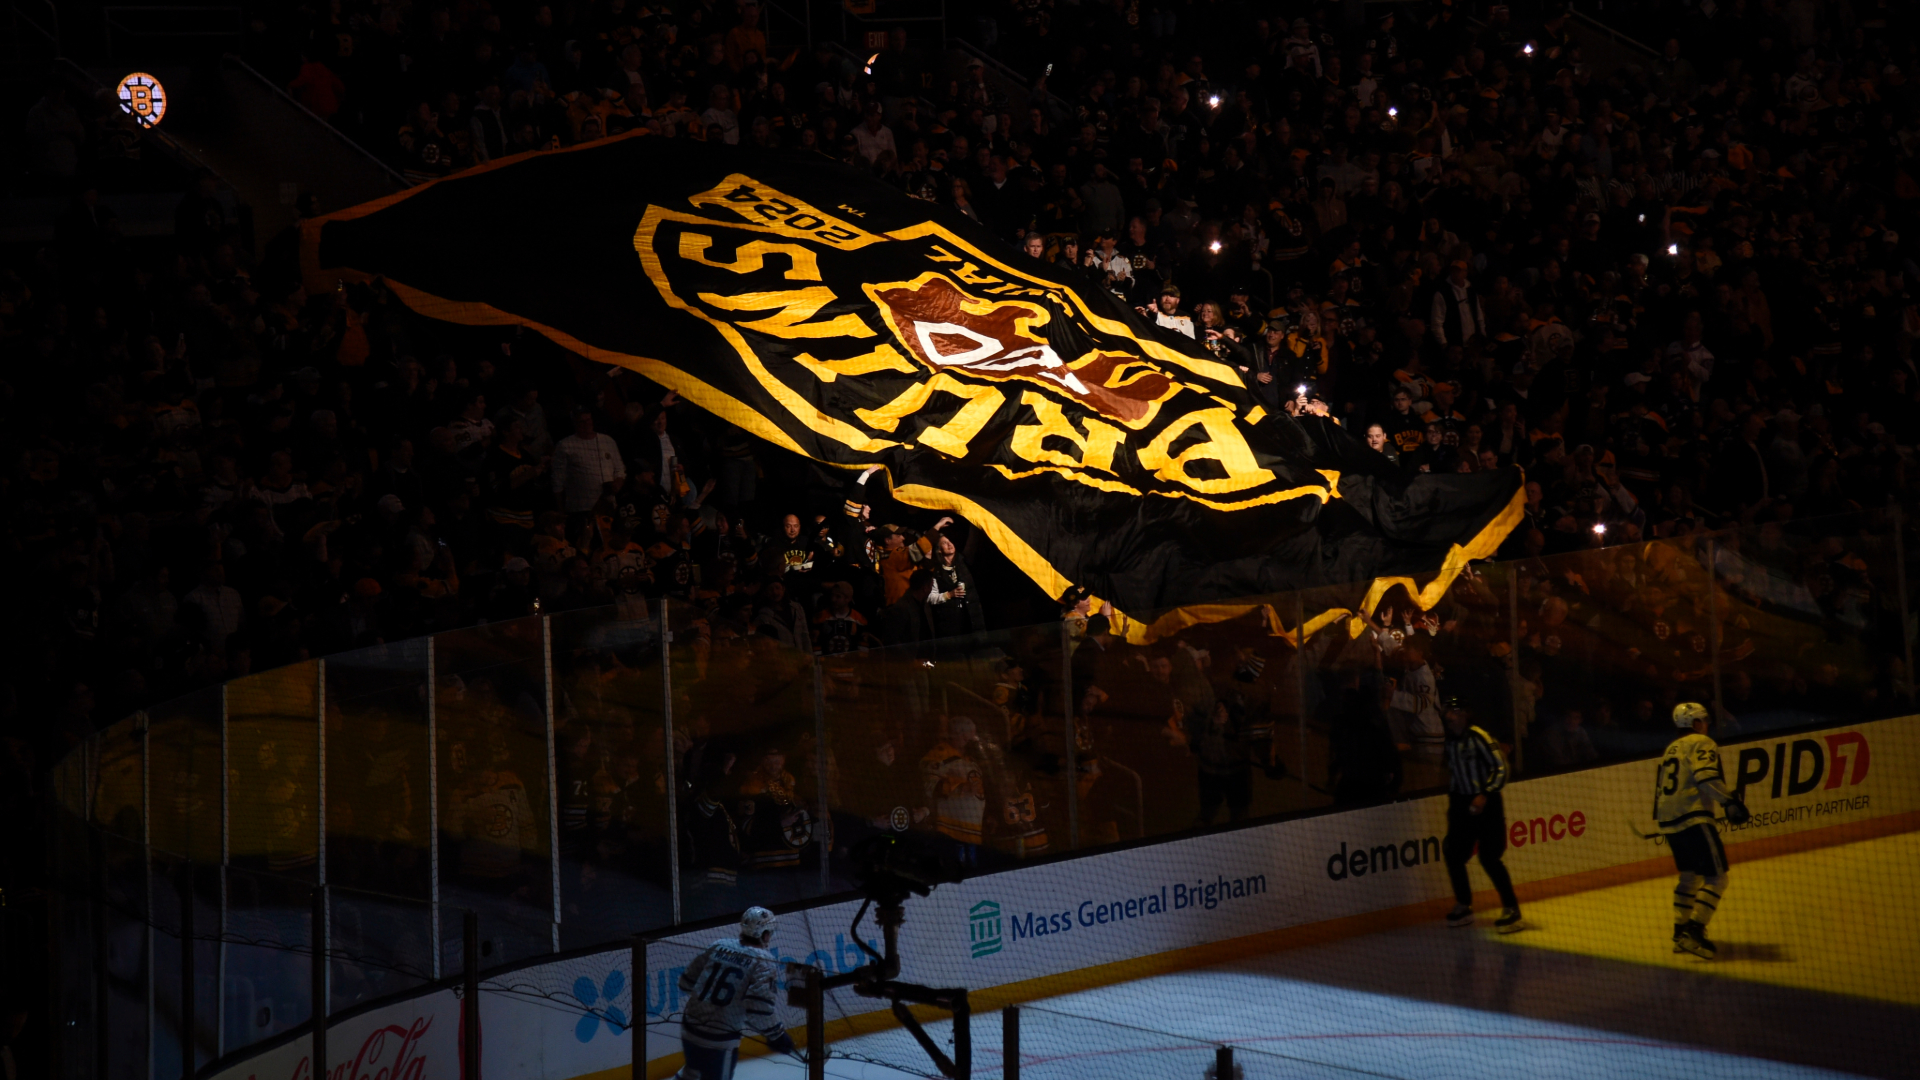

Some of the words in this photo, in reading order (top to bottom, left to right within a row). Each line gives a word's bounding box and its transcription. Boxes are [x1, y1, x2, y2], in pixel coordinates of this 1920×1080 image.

[868, 31, 885, 48] EXIT
[129, 86, 153, 117] B
[723, 185, 861, 244] 2024
[678, 231, 1276, 488] BRUINS
[1697, 749, 1716, 761] 23
[1815, 795, 1869, 816] PARTNER
[1011, 912, 1072, 942] Mass
[1078, 886, 1166, 927] General
[1174, 874, 1266, 910] Brigham
[698, 962, 744, 1007] 16
